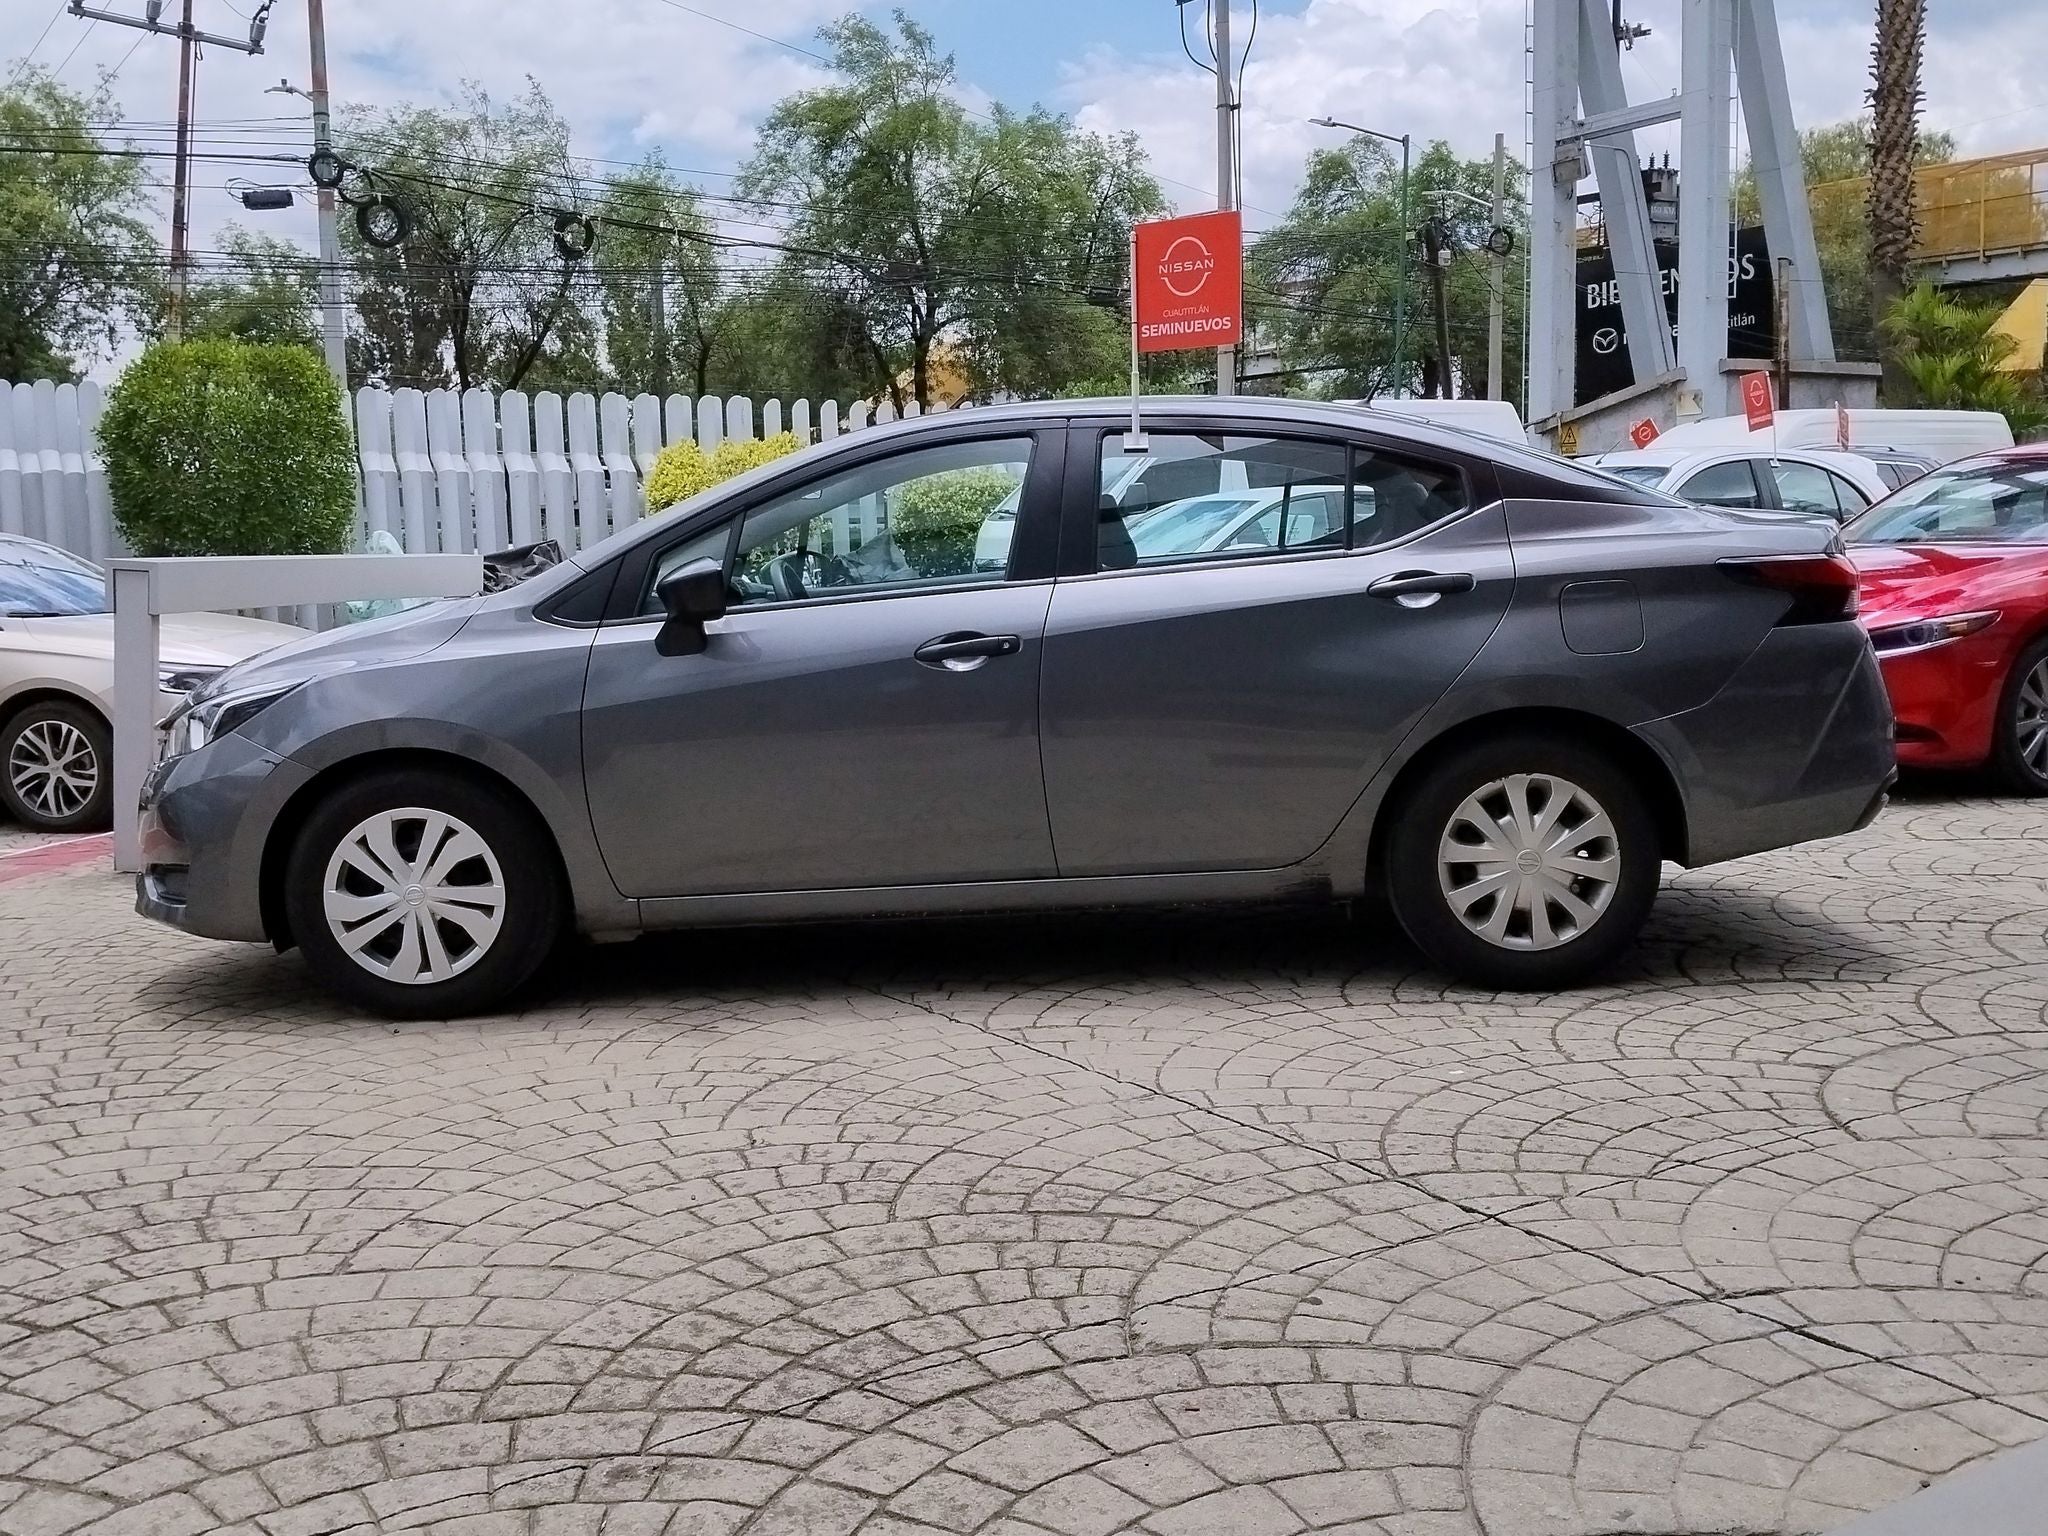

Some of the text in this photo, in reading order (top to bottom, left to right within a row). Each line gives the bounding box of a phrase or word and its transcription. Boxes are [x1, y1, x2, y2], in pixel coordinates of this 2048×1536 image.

[1158, 258, 1214, 275] NISSAN
[1163, 304, 1210, 318] CUAUTITLÁN
[1141, 316, 1232, 338] SEMINUEVOS
